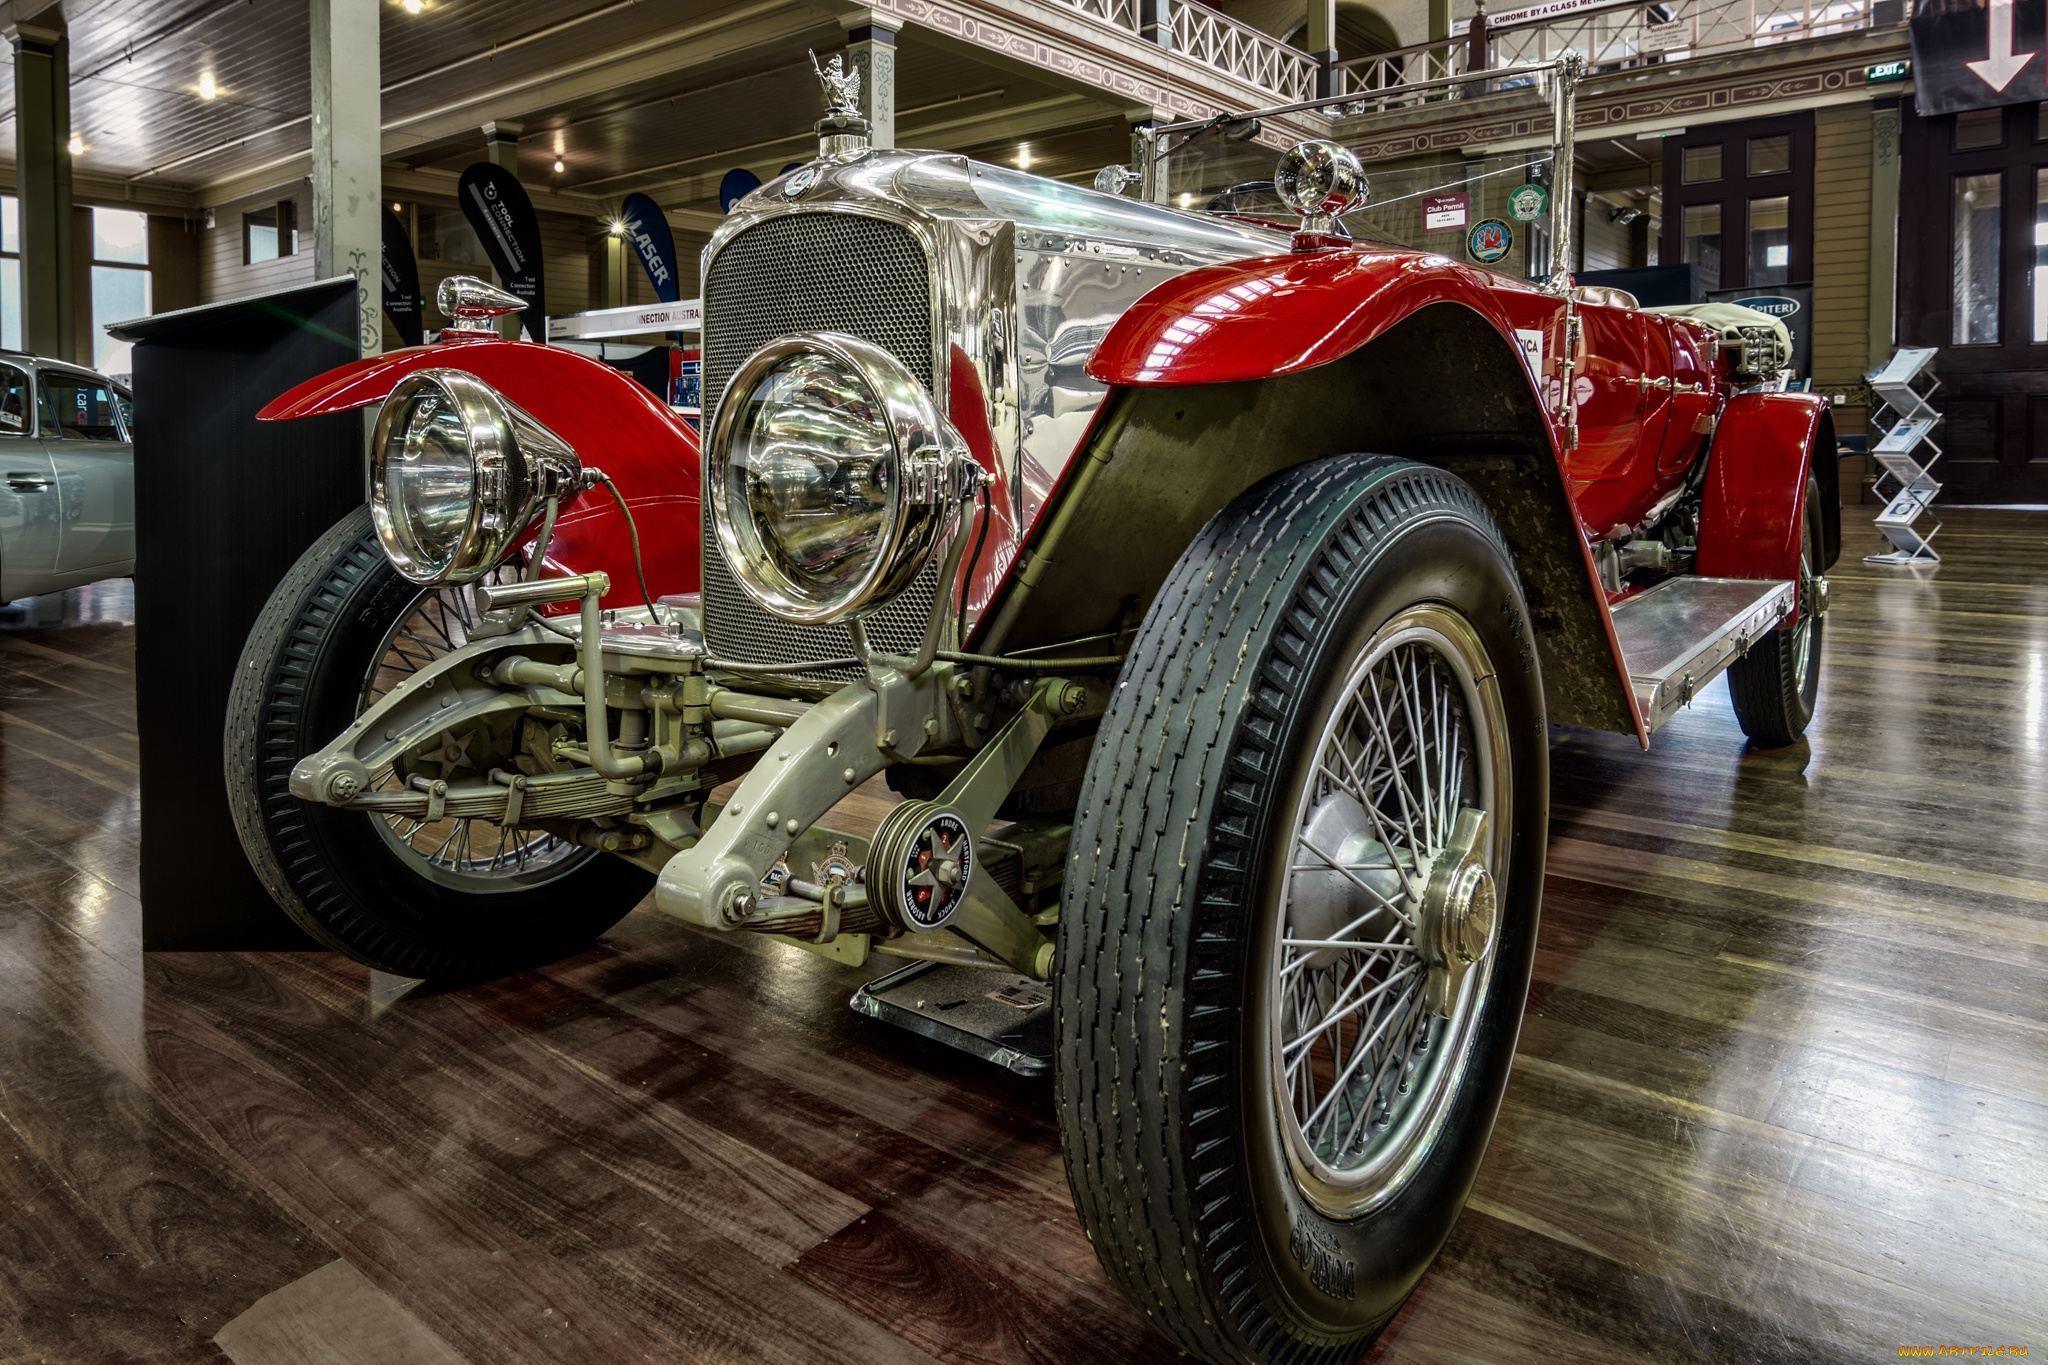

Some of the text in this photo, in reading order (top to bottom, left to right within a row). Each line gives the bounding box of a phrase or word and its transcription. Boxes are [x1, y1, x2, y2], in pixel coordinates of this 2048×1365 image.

[1494, 11, 1528, 24] CHROME
[1530, 9, 1541, 17] BY
[1550, 1, 1577, 12] CLASS
[1875, 63, 1899, 76] EXIT
[498, 200, 514, 228] TOOL
[1443, 203, 1465, 211] Permit
[483, 209, 501, 239] Australia
[491, 204, 526, 262] CONNECTION
[629, 219, 669, 287] LASER
[381, 256, 401, 284] CTION
[940, 819, 970, 881] ANDRE HARTFORD
[942, 834, 947, 844] 2
[906, 889, 956, 921] SHOCK ABSORBER
